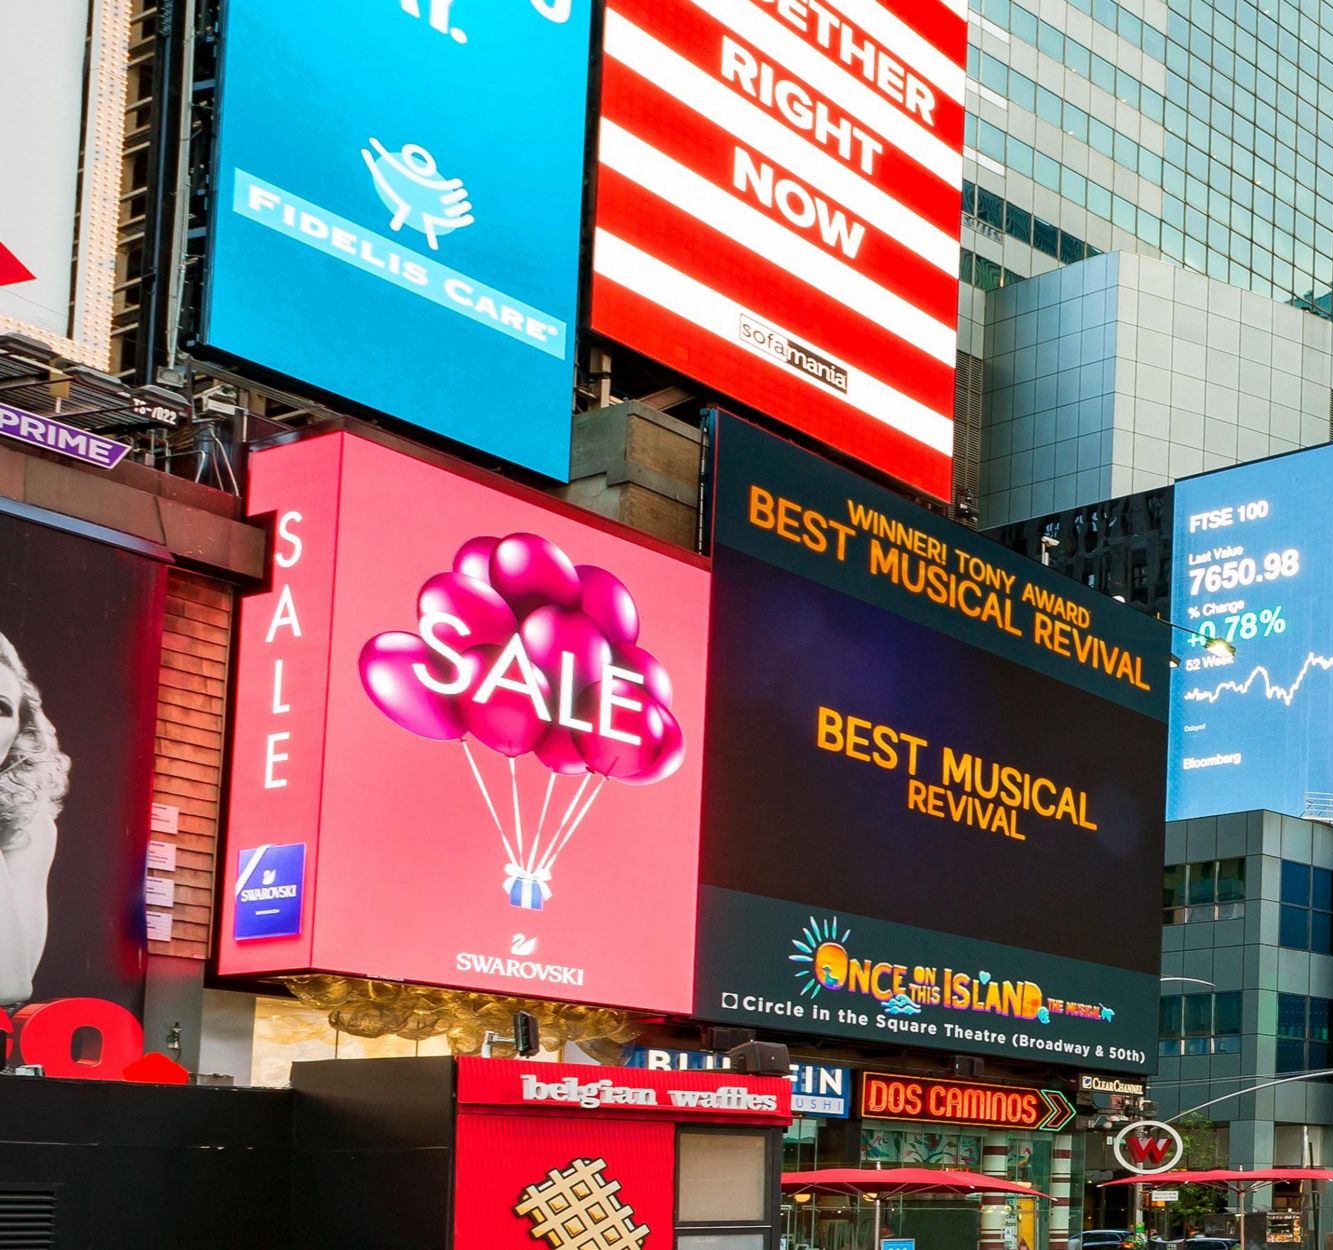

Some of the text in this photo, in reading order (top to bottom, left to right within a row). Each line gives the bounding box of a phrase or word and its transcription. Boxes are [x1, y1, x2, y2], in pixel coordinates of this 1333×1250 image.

[757, 0, 937, 127] ETHER
[720, 34, 884, 176] RIGHT
[732, 144, 866, 261] NOW
[247, 183, 429, 287] FIDELIS
[740, 318, 848, 392] sofamania
[0, 406, 113, 463] PRIME
[1189, 499, 1269, 533] FTSE 100
[847, 498, 1090, 630] WINNER! TONY AWARD
[1188, 544, 1245, 566] Last Value
[1189, 548, 1300, 596] 7650.98
[749, 484, 1151, 691] BEST MUSICAL REVIVAL
[1202, 599, 1245, 617] Change
[263, 510, 302, 790] SALE
[1185, 656, 1202, 672] 52
[413, 610, 645, 747] SALE
[817, 705, 1098, 832] BEST MUSICAL
[1183, 751, 1242, 771] Bloomberg
[907, 778, 1027, 841] REVIVAL
[240, 883, 298, 902] SWAROVSKI
[456, 951, 584, 987] SWAROVSKI
[814, 942, 907, 1001] ONCE
[909, 983, 941, 1006] THIS
[913, 965, 936, 985] ON
[943, 968, 1043, 1022] ISLAND
[1047, 997, 1064, 1015] THE
[742, 995, 1146, 1065] Circle in the Square Theatre (Broadway & 50th)
[520, 1074, 778, 1112] belgian waffles
[795, 1097, 843, 1114] USHI
[869, 1079, 1038, 1124] DOS CAMINOS
[1125, 1135, 1174, 1165] W
